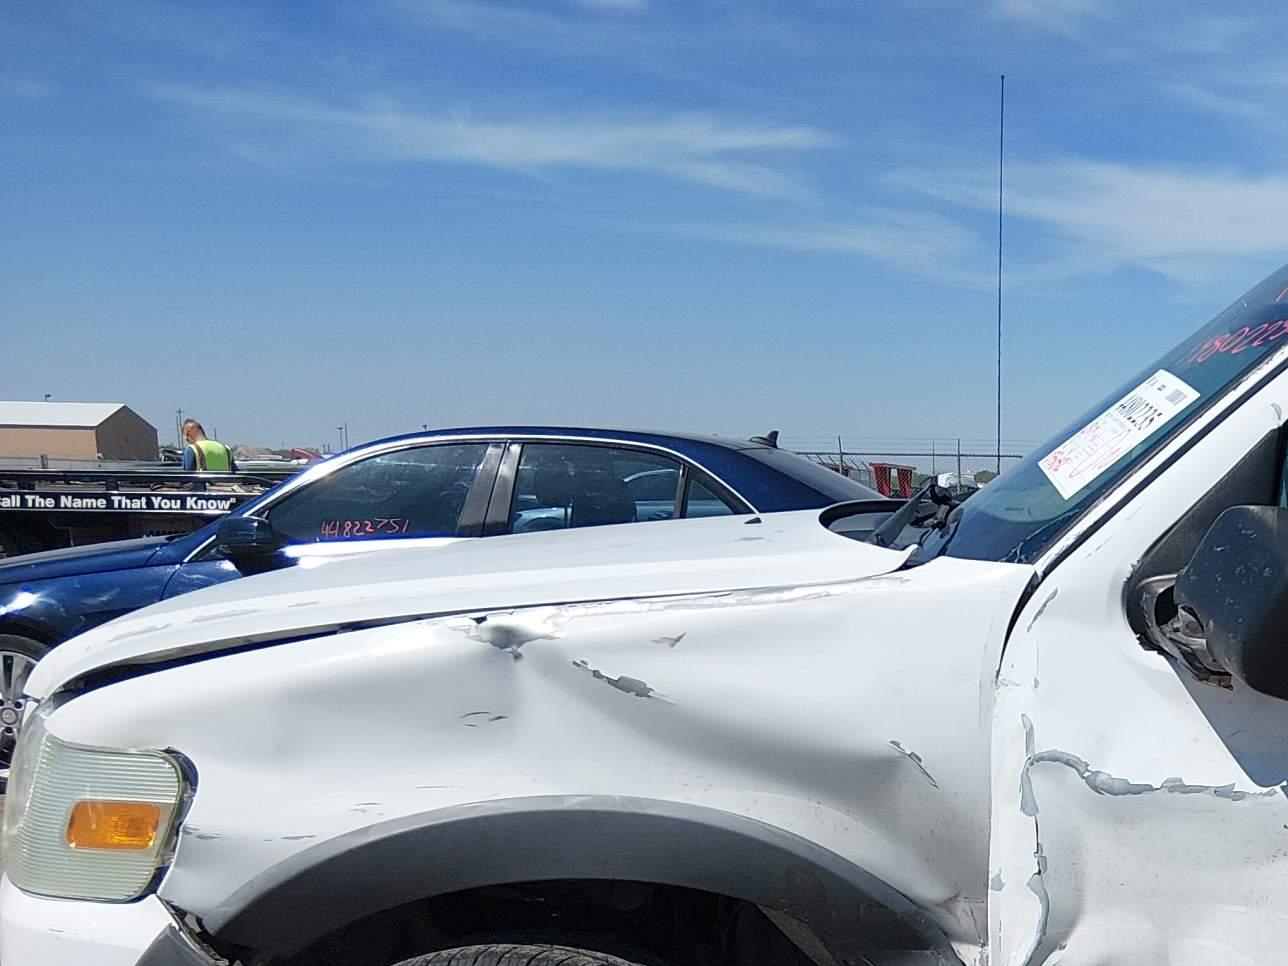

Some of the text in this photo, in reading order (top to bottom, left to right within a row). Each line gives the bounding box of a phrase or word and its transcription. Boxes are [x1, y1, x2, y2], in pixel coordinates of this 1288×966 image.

[0, 494, 21, 508] all
[24, 494, 56, 508] The
[60, 495, 107, 509] Name
[111, 495, 147, 509] That
[151, 496, 181, 509] You
[321, 516, 409, 538] 44822751
